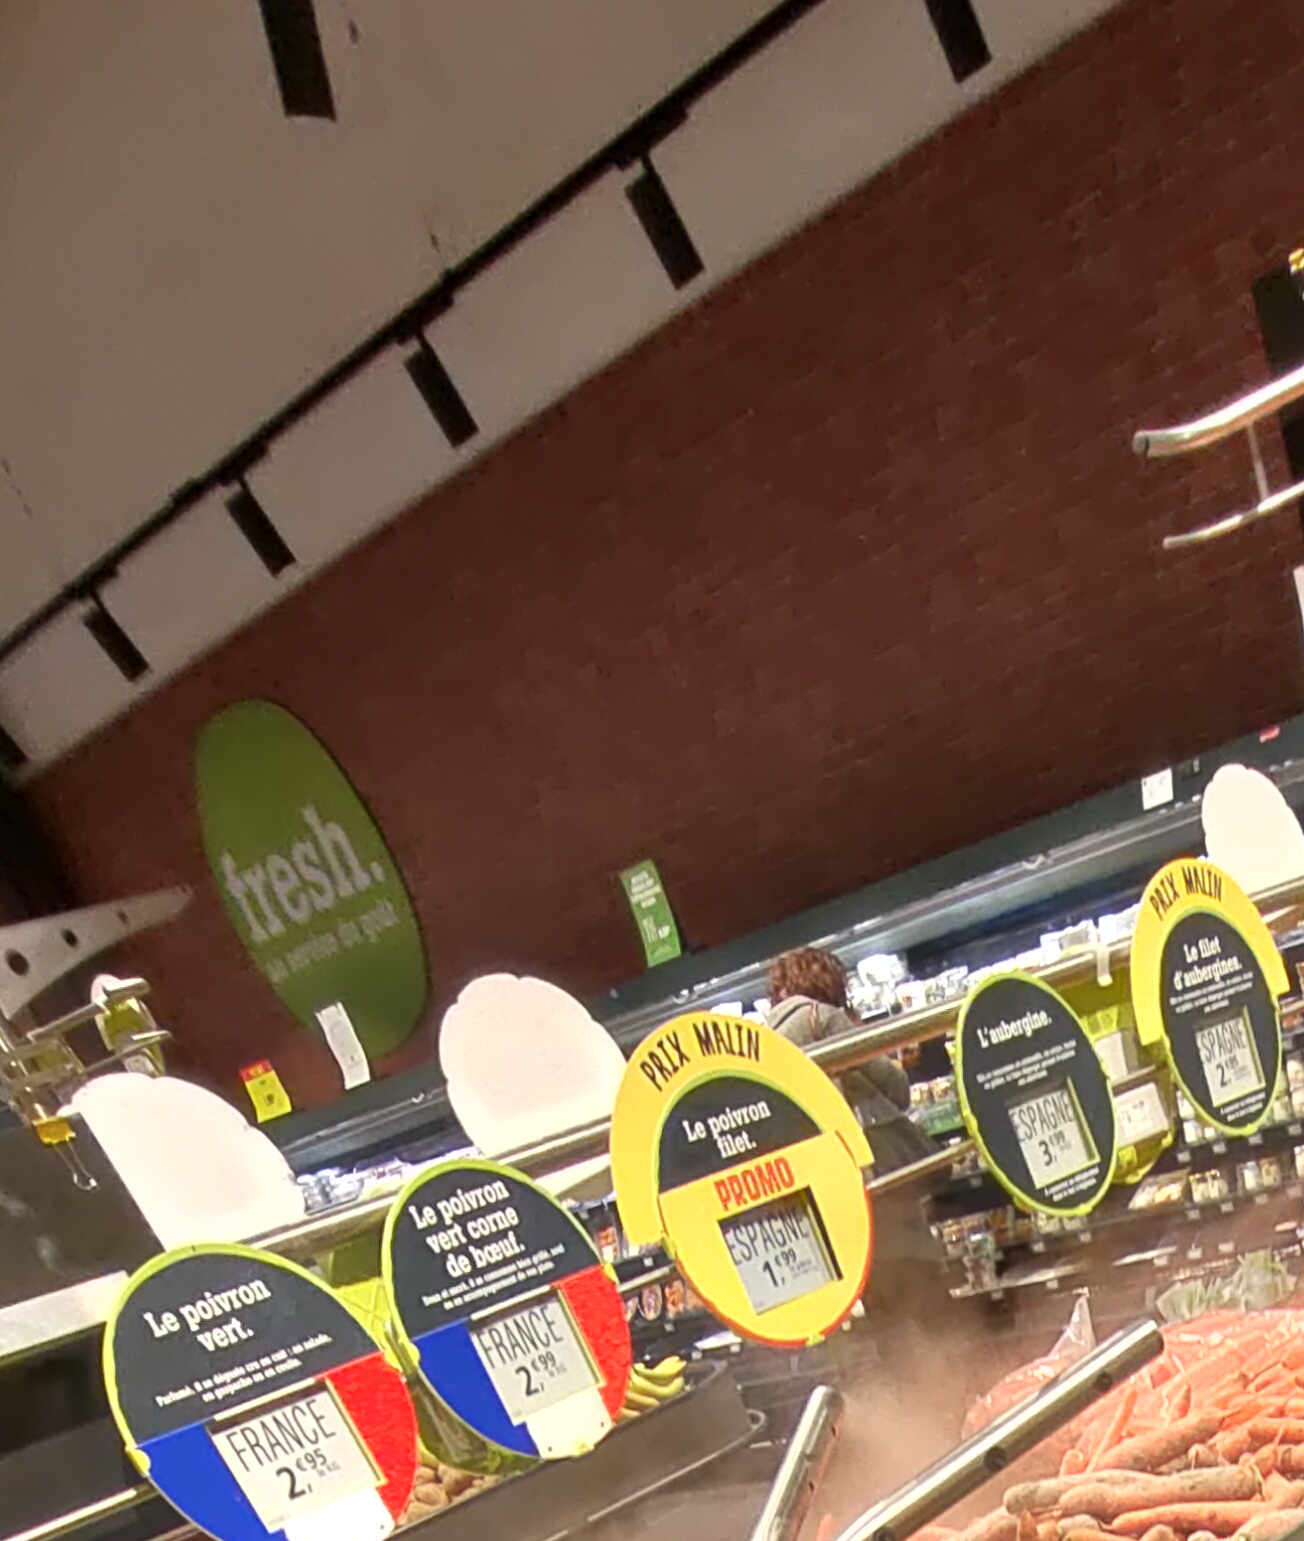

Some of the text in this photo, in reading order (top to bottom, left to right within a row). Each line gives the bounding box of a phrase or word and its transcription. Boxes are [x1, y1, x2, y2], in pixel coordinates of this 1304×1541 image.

[1149, 865, 1223, 922] PRIX MALIN
[1183, 935, 1222, 964] Le filet
[976, 1009, 1052, 1048] L'aubergine.
[1201, 1020, 1246, 1063] SPAGNE
[639, 1021, 761, 1093] PRIX MALIN
[681, 1099, 771, 1143] Le poivron
[716, 1130, 757, 1159] filet.
[408, 1180, 510, 1230] Le poivron
[713, 1156, 796, 1212] PROMO
[425, 1205, 519, 1254] vert corne
[445, 1253, 472, 1278] de
[143, 1278, 271, 1338] Le poivron
[197, 1319, 254, 1351] vert.
[476, 1304, 564, 1370] FRANCE
[226, 1398, 336, 1473] FRANCE
